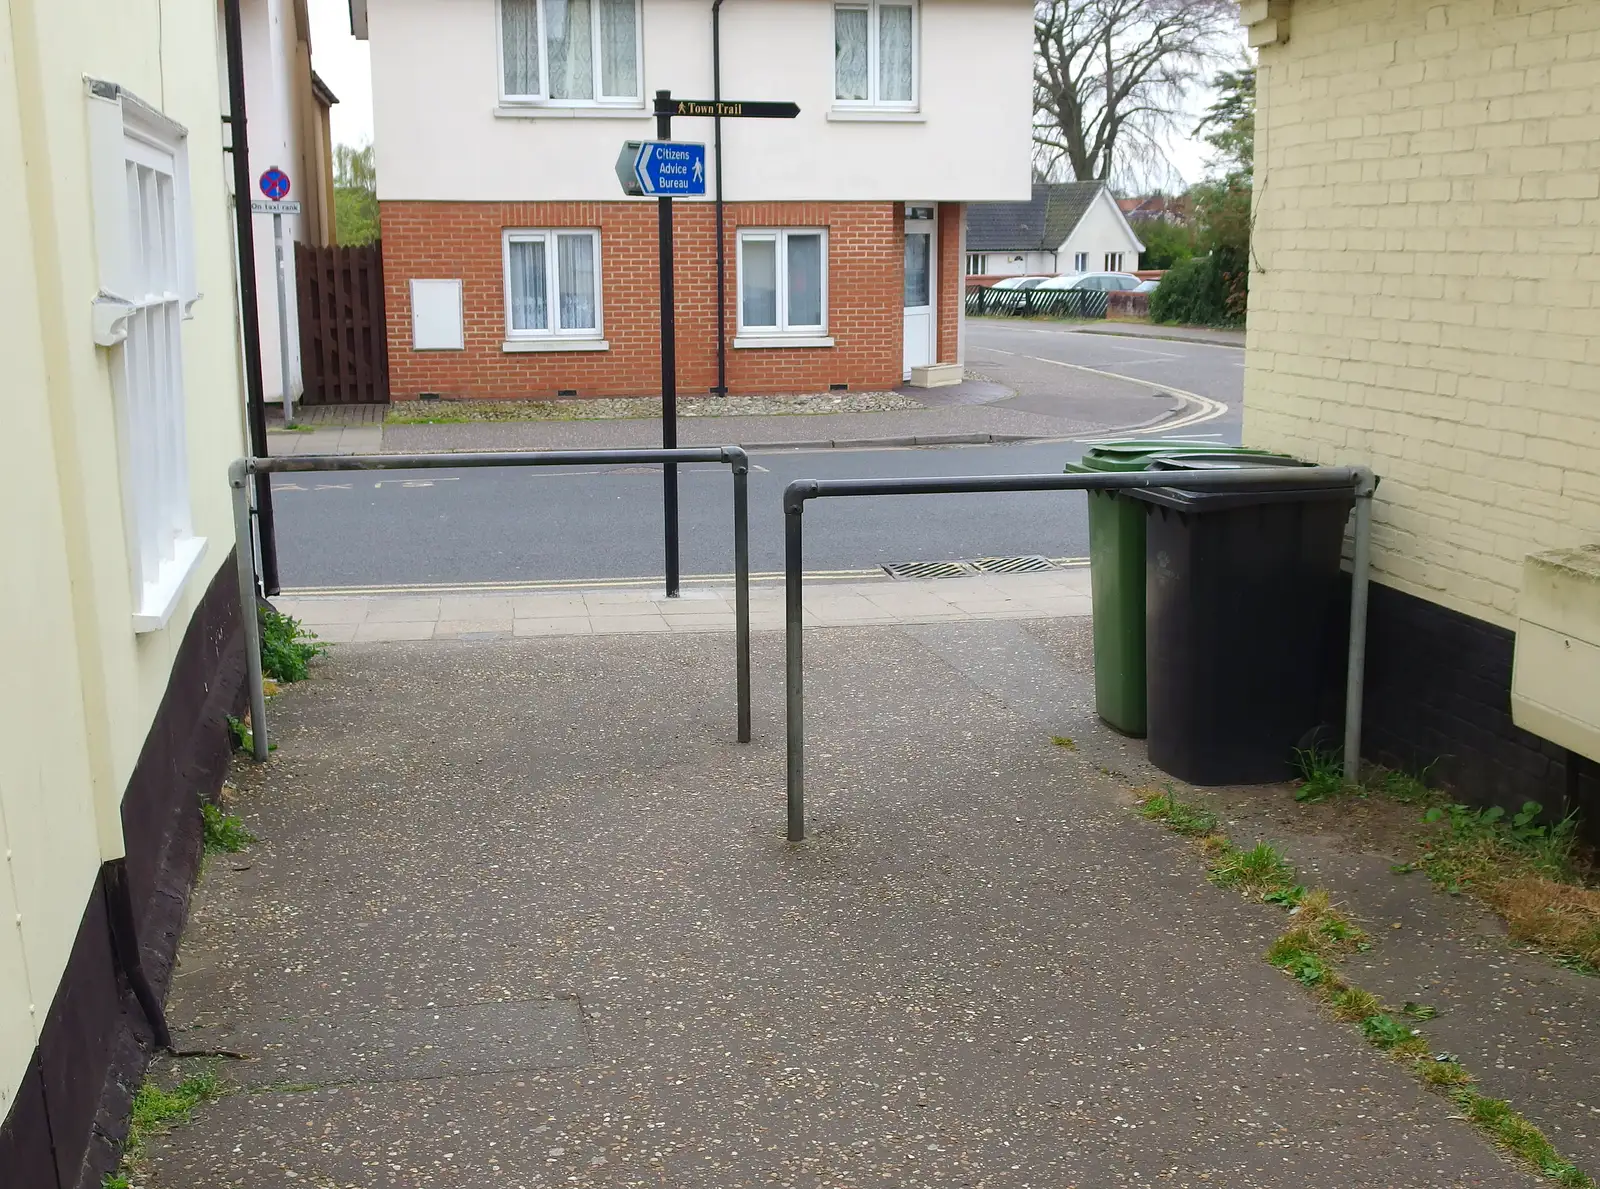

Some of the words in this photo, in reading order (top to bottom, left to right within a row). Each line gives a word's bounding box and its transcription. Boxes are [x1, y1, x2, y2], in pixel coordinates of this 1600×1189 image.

[687, 102, 714, 114] Town
[716, 102, 742, 115] Trail
[656, 147, 690, 160] Citizens
[659, 162, 687, 174] Advice
[659, 176, 689, 188] Bureau
